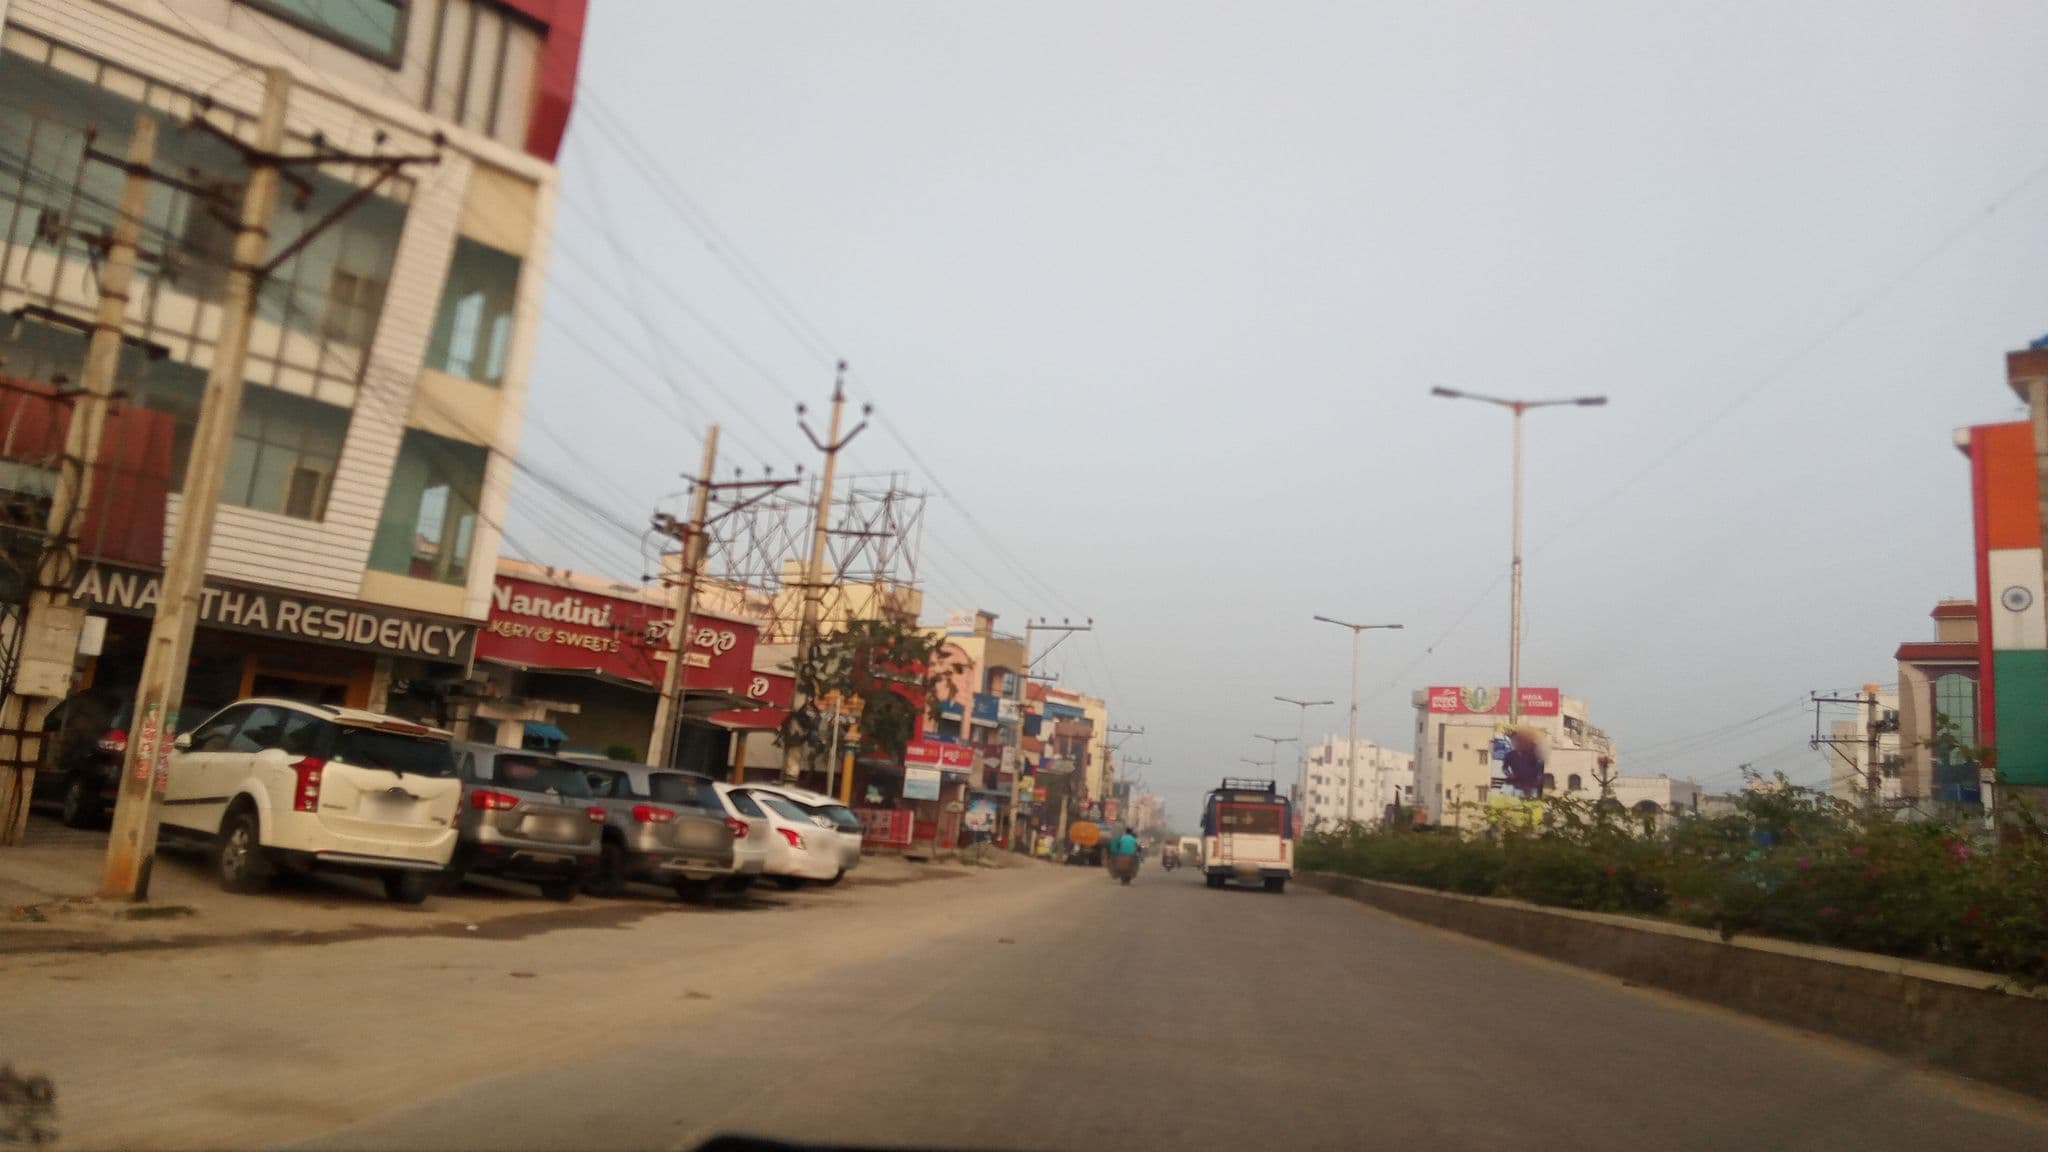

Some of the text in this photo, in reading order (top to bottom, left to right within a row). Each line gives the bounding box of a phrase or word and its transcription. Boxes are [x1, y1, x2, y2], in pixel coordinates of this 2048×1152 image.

[72, 567, 465, 657] ANATHA RESIDENCY
[492, 584, 611, 627] Nandini
[489, 617, 622, 653] KERY & SWEETS
